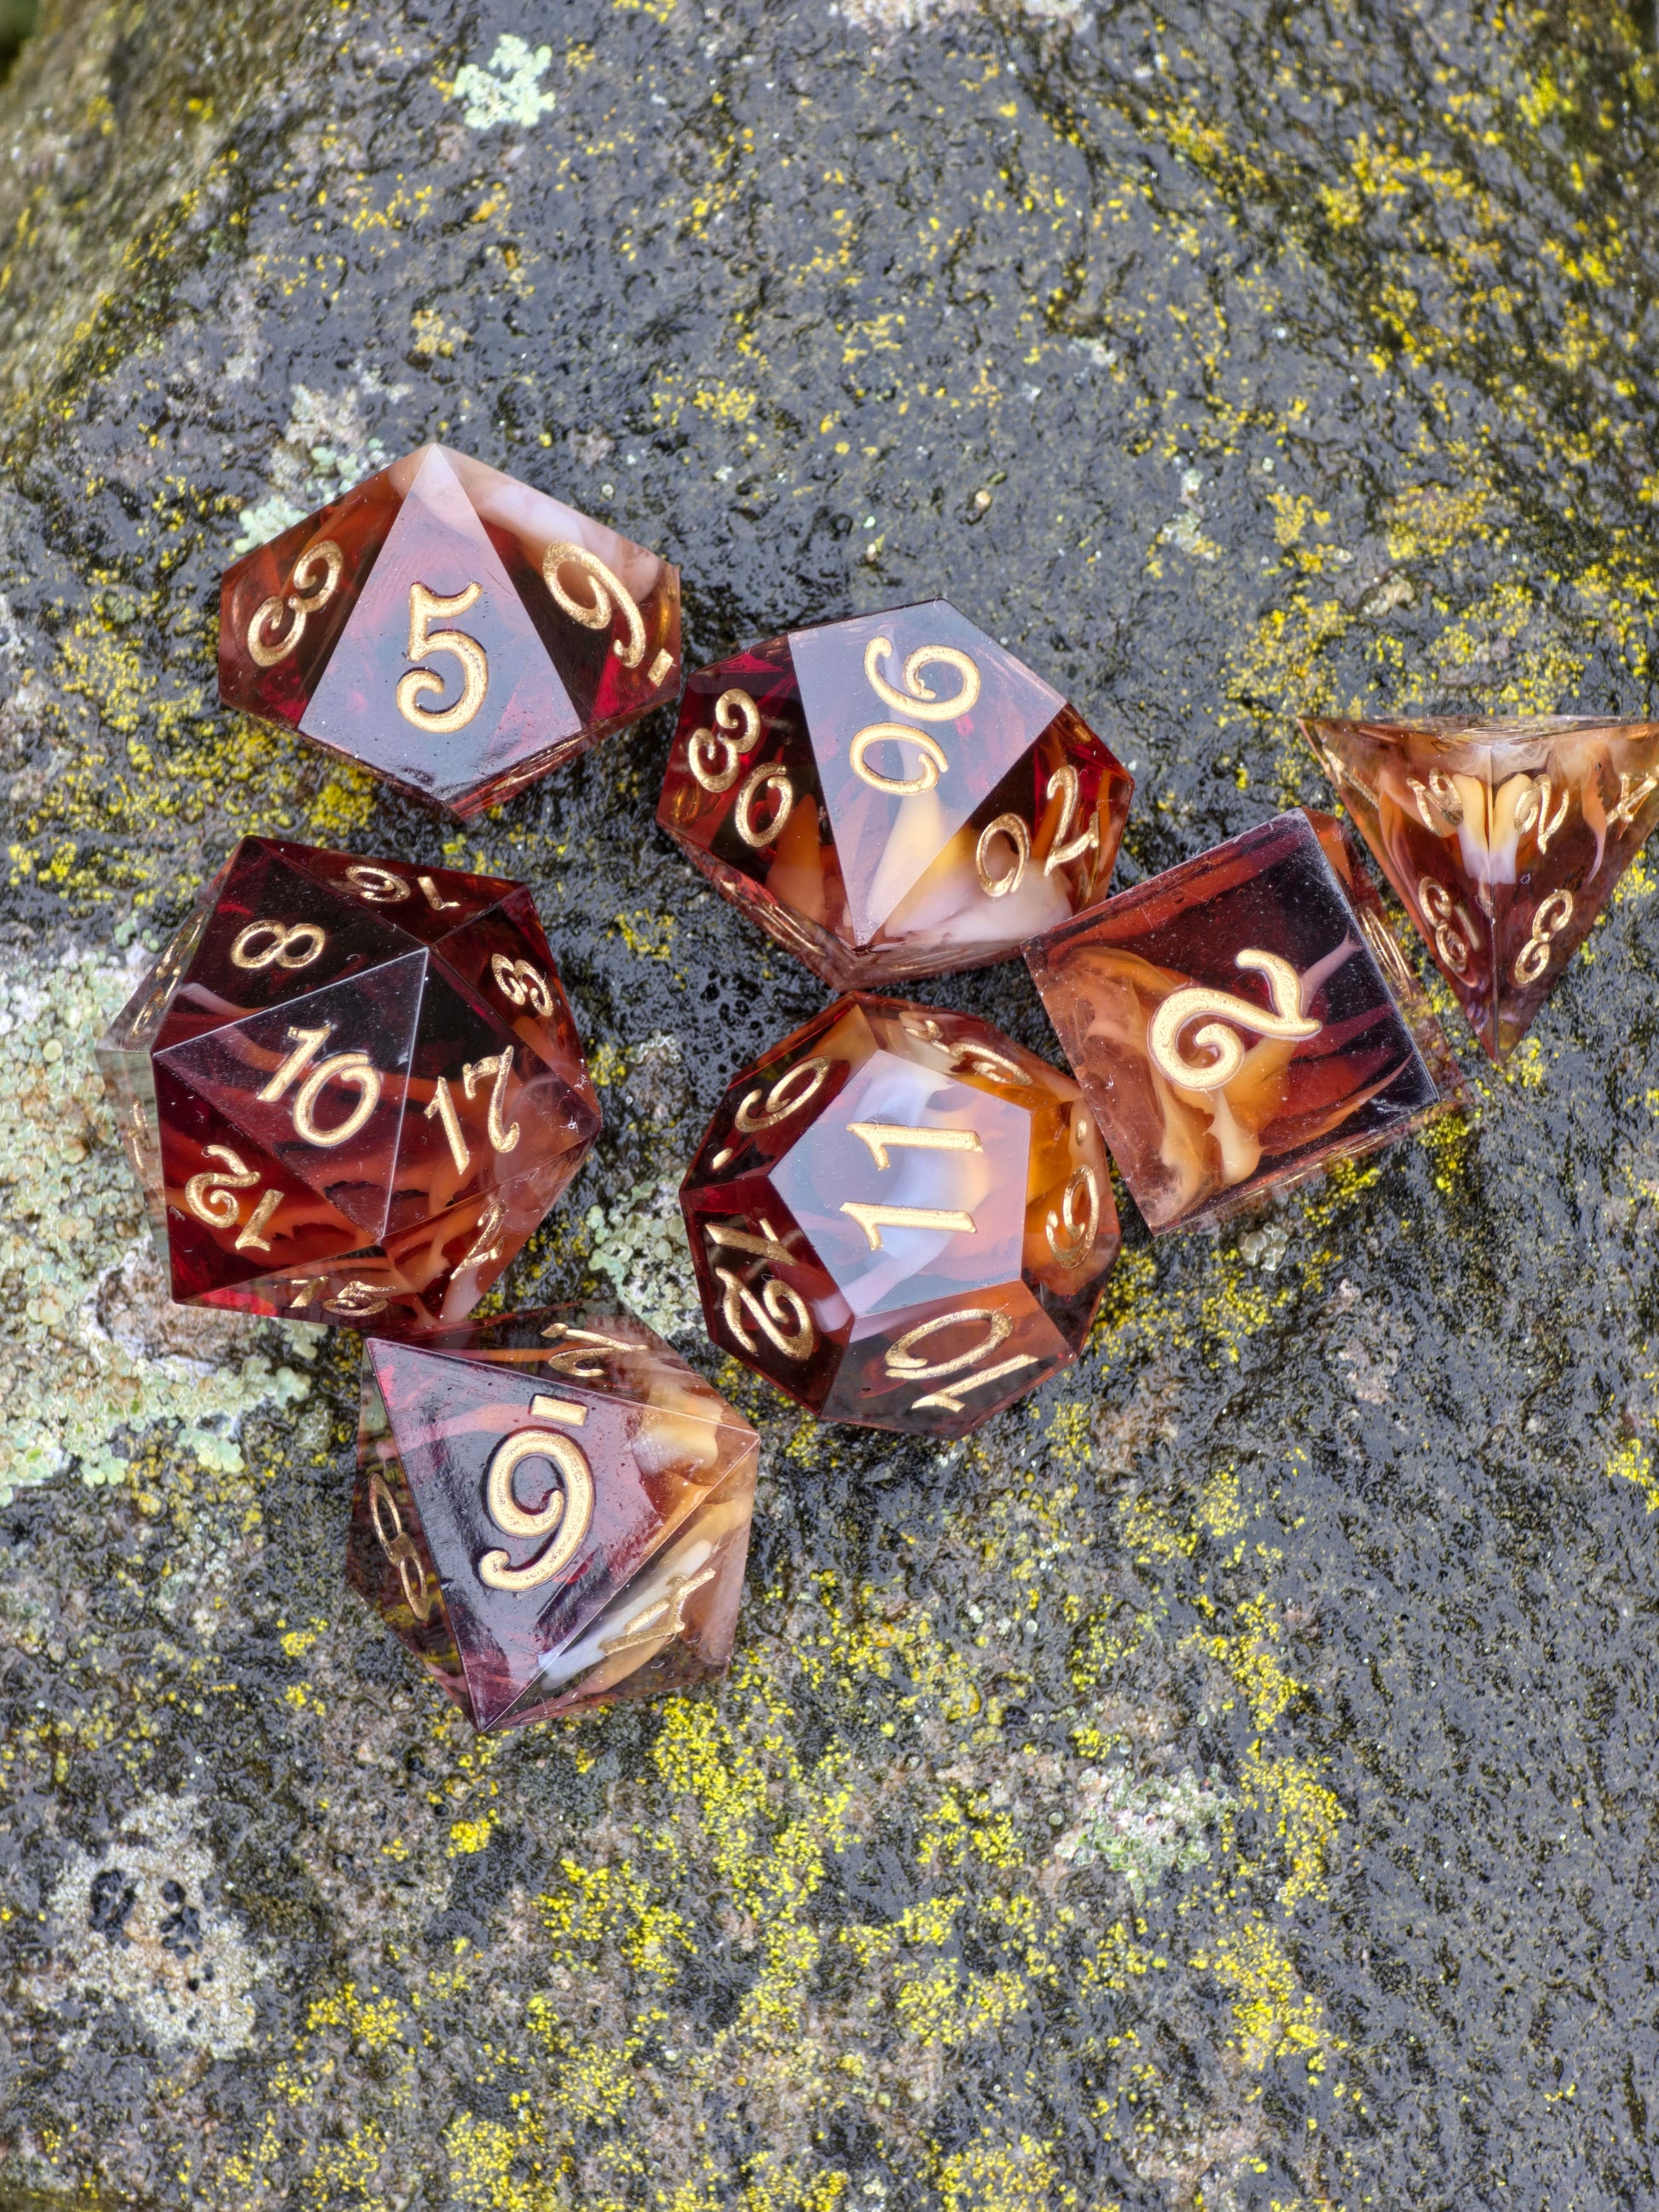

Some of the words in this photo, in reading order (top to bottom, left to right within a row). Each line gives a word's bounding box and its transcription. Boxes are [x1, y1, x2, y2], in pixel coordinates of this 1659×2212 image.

[396, 581, 489, 733] 5
[231, 920, 326, 969] 8
[1149, 948, 1321, 1089] 2
[257, 1020, 381, 1147] 10
[424, 1044, 520, 1175] 17
[185, 1144, 285, 1251] 12
[840, 1123, 984, 1250] 11
[705, 1218, 814, 1360] 12
[885, 1308, 1038, 1412] 10
